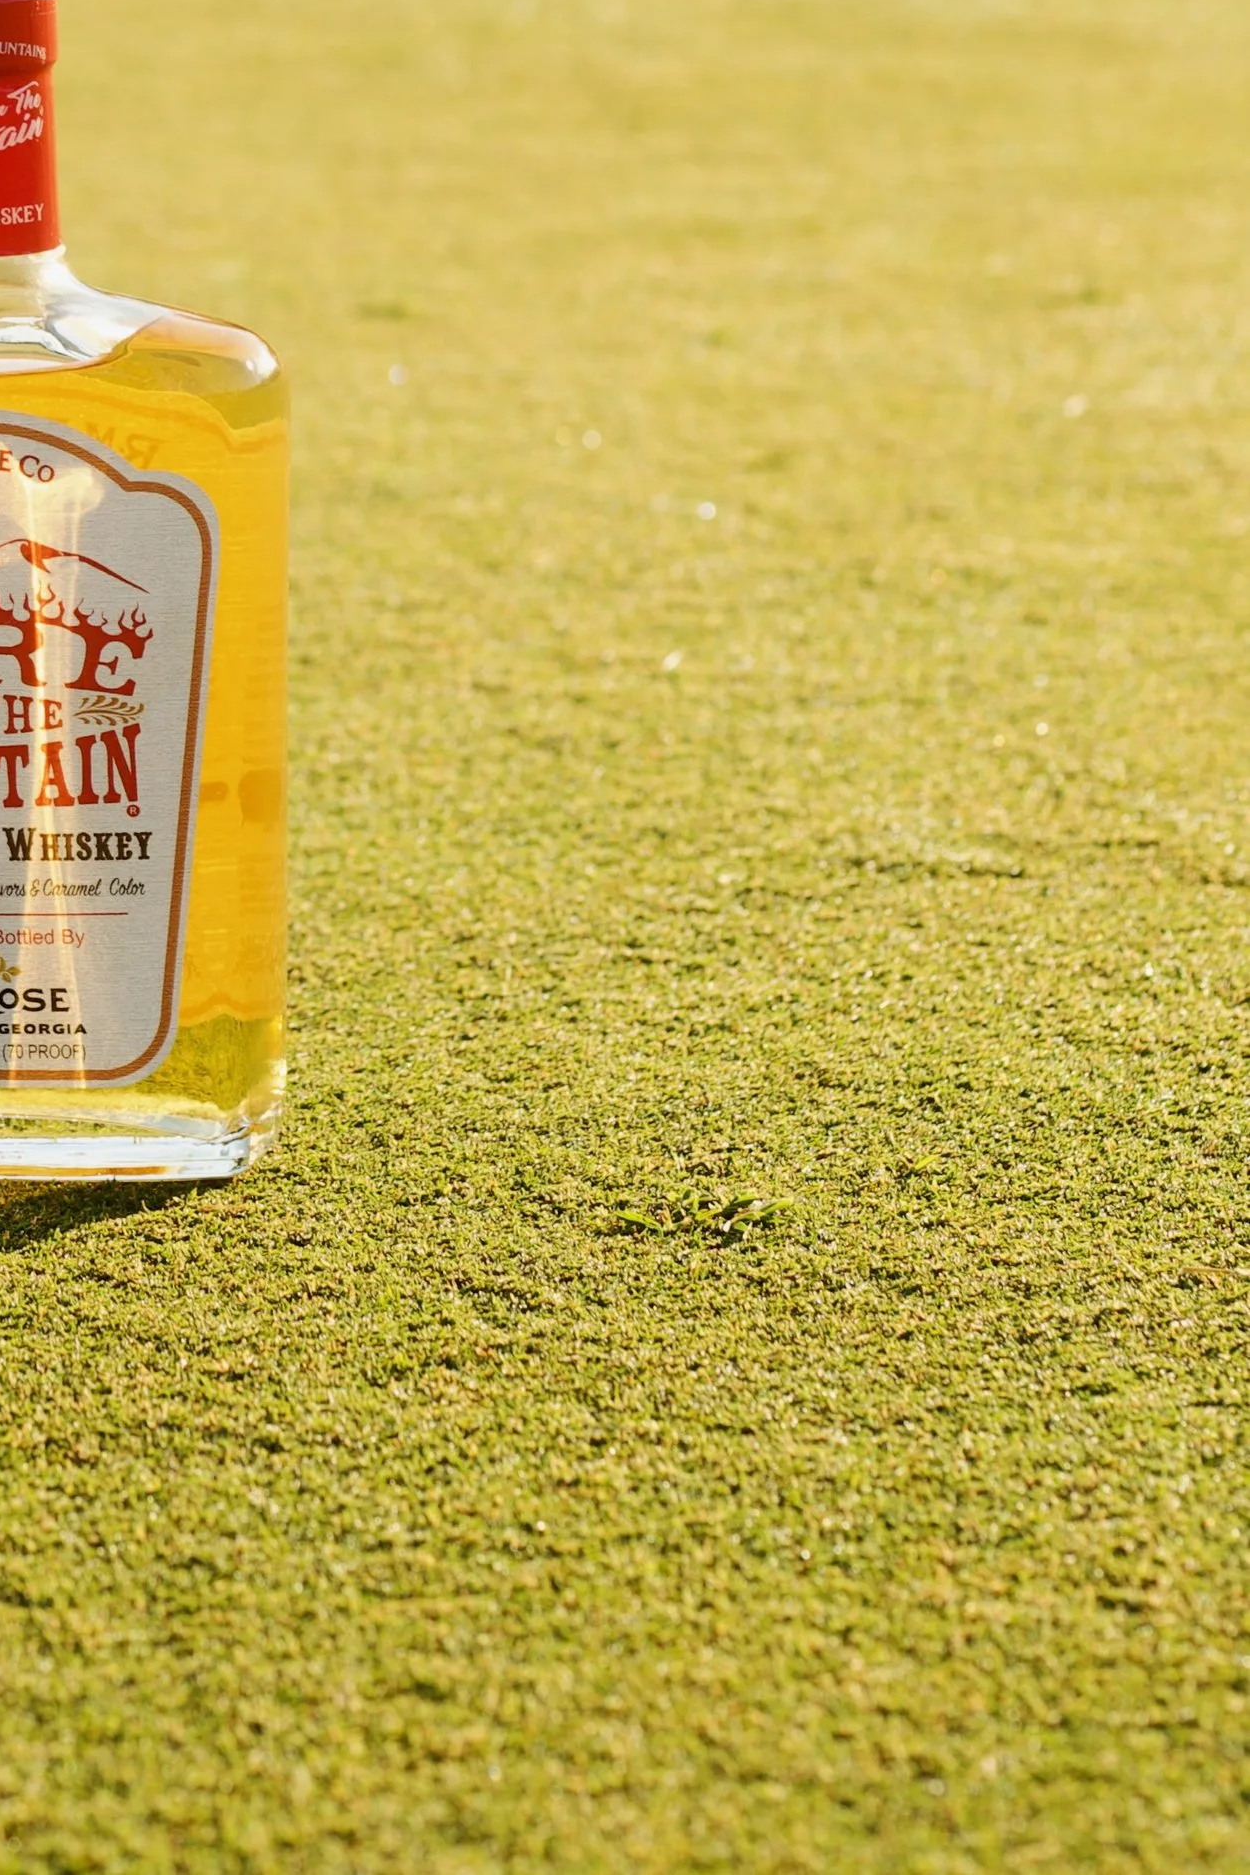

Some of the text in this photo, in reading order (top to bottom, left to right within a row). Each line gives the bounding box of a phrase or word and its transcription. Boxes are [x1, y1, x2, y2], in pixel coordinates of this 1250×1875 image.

[6, 81, 42, 115] The
[1, 827, 153, 863] WHISKEY
[30, 879, 39, 897] &
[42, 878, 102, 898] Caramel
[109, 877, 146, 897] Color
[62, 929, 85, 949] By
[2, 1043, 24, 1063] (70
[28, 1043, 87, 1063] PROOF)
